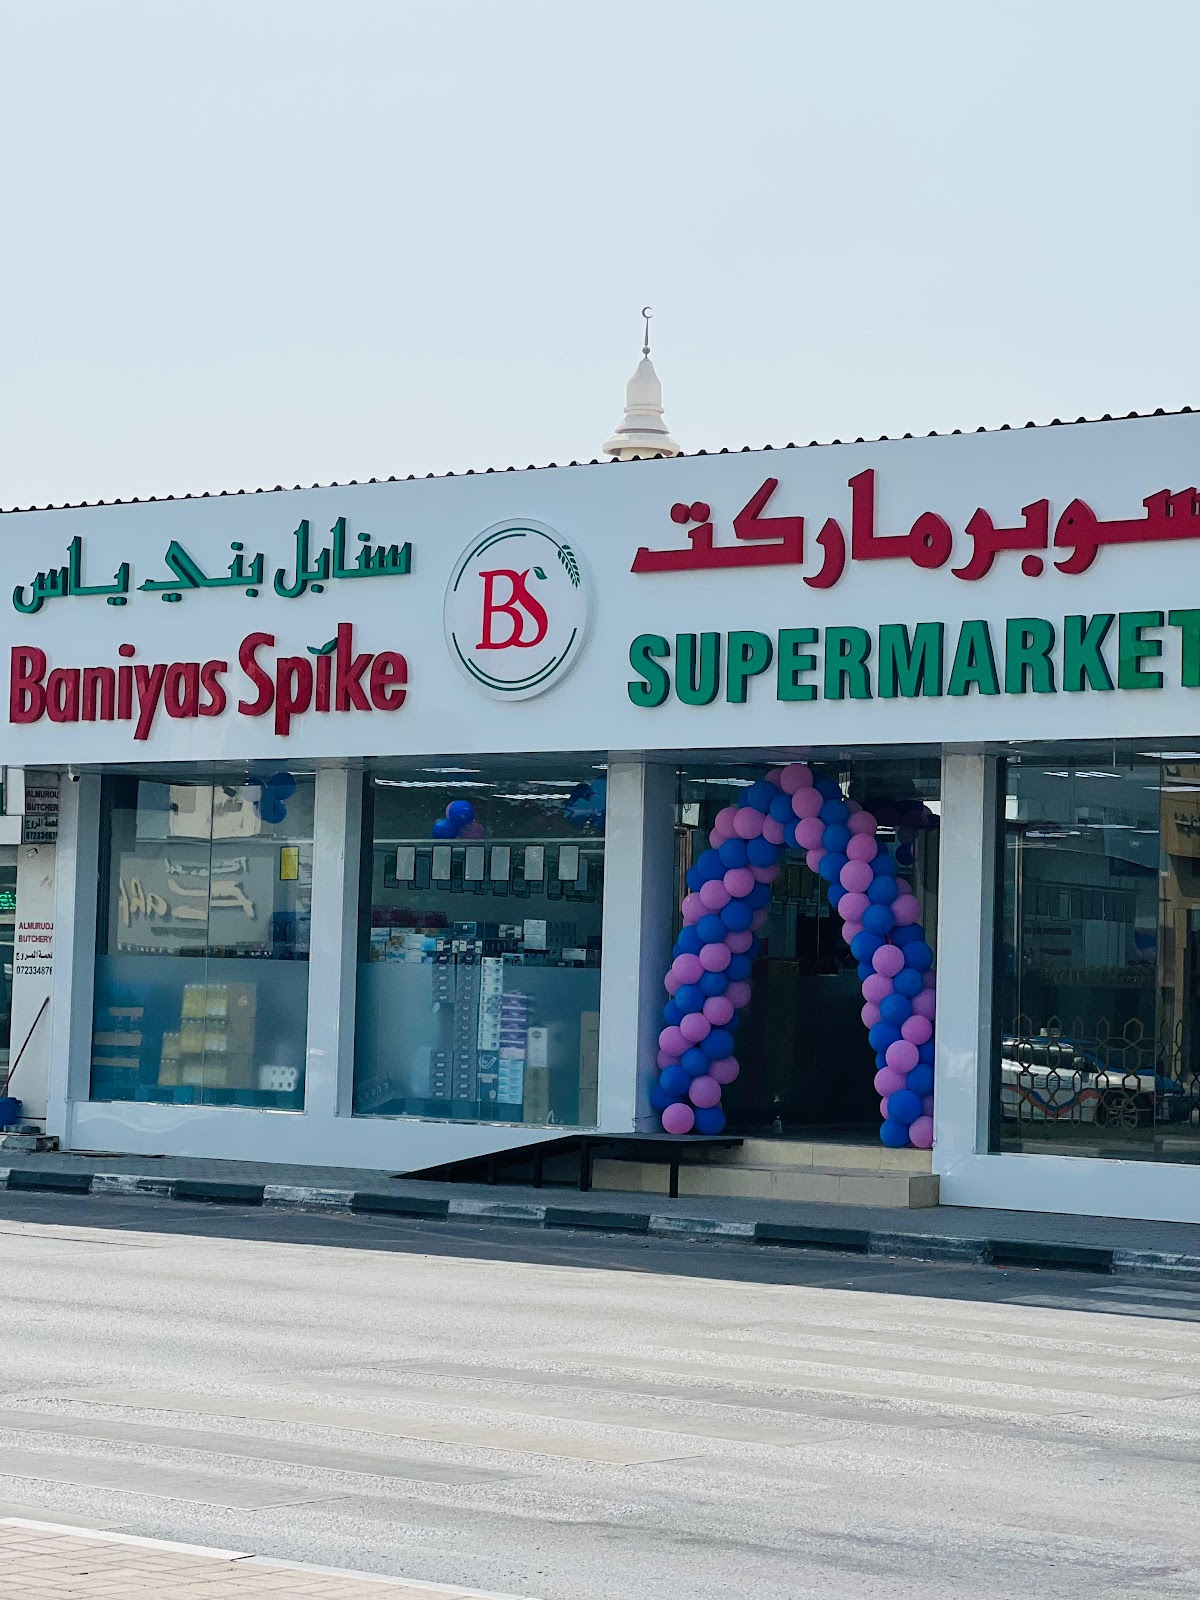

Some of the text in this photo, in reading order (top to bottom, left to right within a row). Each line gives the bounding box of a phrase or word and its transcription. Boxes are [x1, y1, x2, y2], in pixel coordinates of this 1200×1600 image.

[13, 516, 412, 614] سنابل بني ياس
[475, 567, 549, 650] BS
[9, 622, 408, 741] Baniyas Spike
[628, 608, 1200, 708] SUPERMARKET
[18, 935, 53, 943] BUTCHERY
